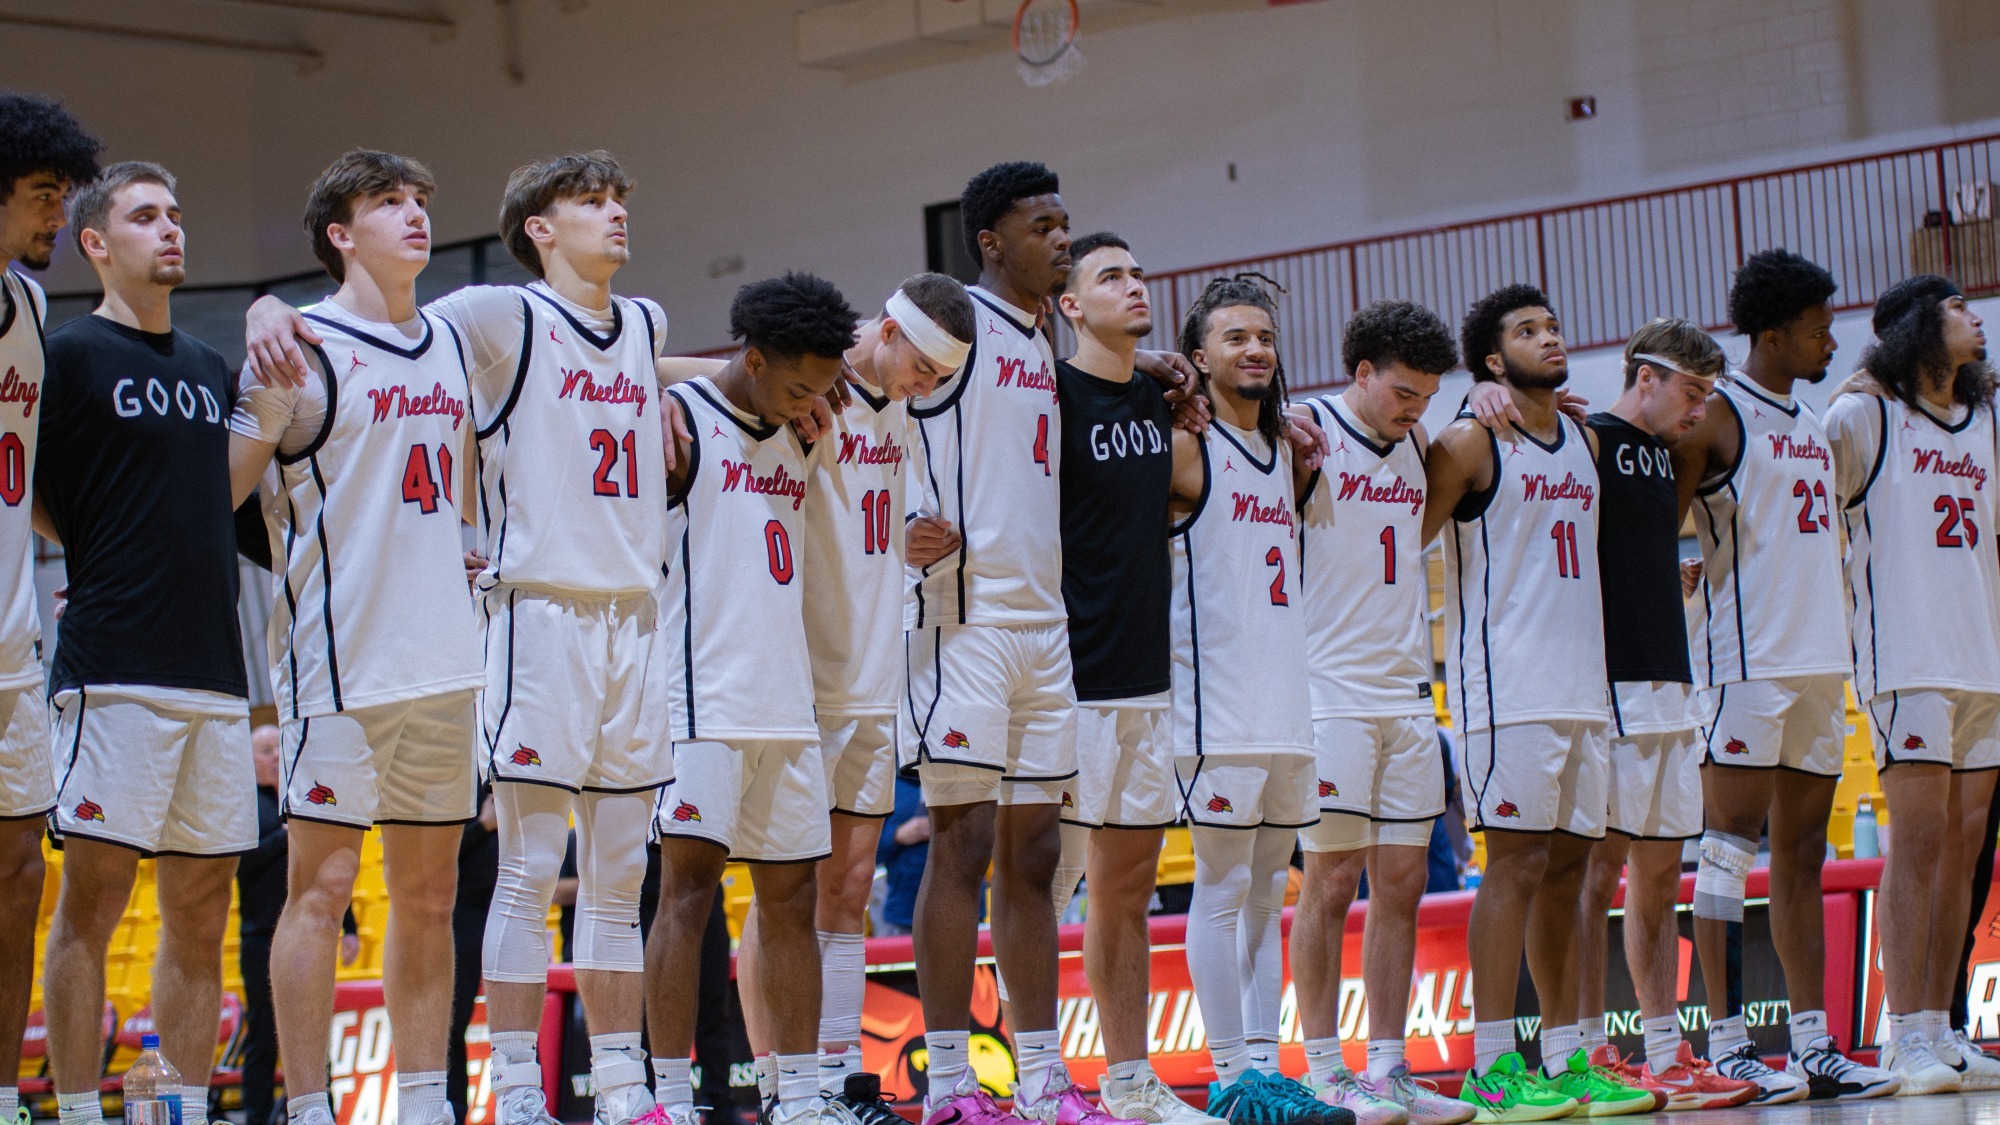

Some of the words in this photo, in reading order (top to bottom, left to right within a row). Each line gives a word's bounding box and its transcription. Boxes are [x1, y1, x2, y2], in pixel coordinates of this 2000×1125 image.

[367, 381, 465, 431] Wheeling
[558, 366, 648, 417] Wheeling
[588, 428, 639, 499] 21
[1033, 413, 1052, 477] 4
[1090, 419, 1168, 481] GOOD.
[1768, 434, 1830, 471] Wheeling
[1912, 447, 1988, 491] Wheeling
[721, 458, 806, 511] Wheeling
[1337, 471, 1425, 516] Wheeling
[1521, 471, 1595, 512] Wheeling
[1793, 479, 1830, 534] 23
[861, 489, 892, 555] 10
[1231, 491, 1295, 540] Wheeling
[1933, 494, 1980, 550] 25
[764, 519, 795, 586] 0
[1265, 545, 1290, 608] 2
[1379, 525, 1397, 585] 1
[1551, 520, 1581, 580] 11
